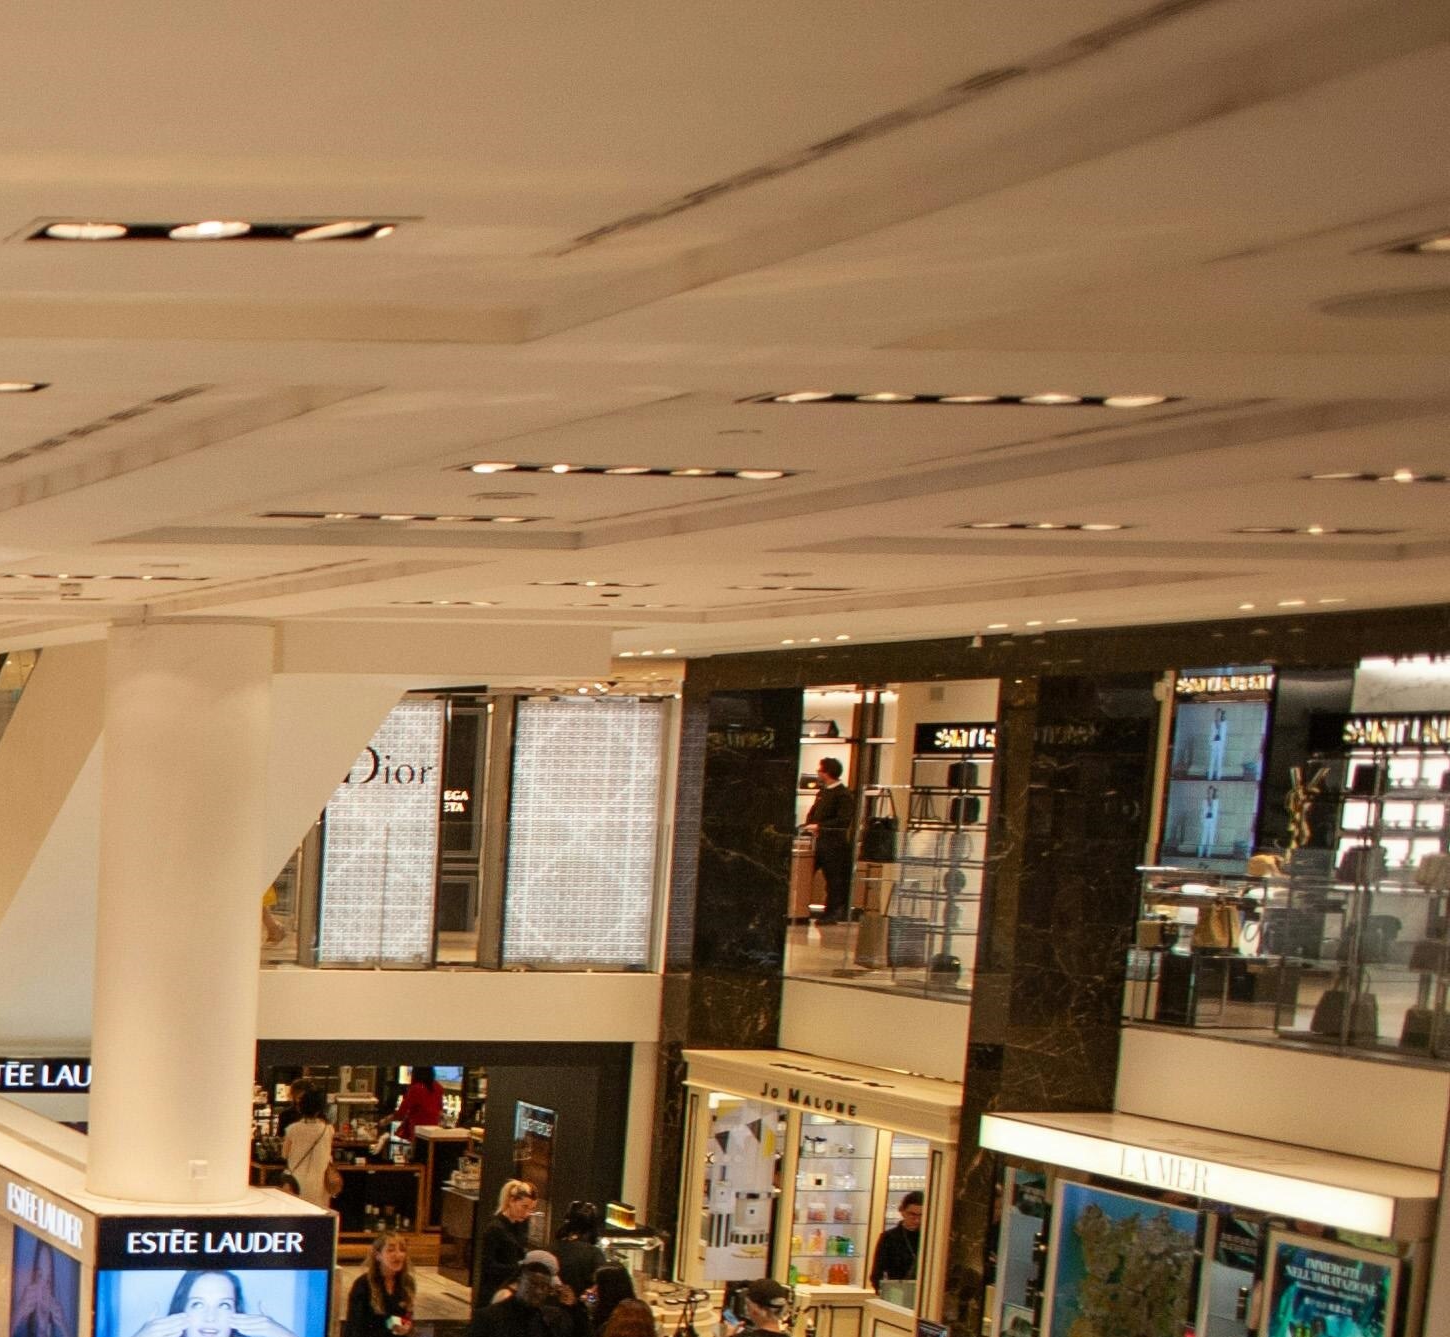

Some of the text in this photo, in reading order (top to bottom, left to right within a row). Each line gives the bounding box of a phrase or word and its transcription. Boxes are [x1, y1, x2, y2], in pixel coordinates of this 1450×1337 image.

[342, 746, 433, 784] Dior
[788, 1087, 857, 1117] MALONE
[1158, 1155, 1209, 1195] MER
[205, 1231, 304, 1254] LAUDER
